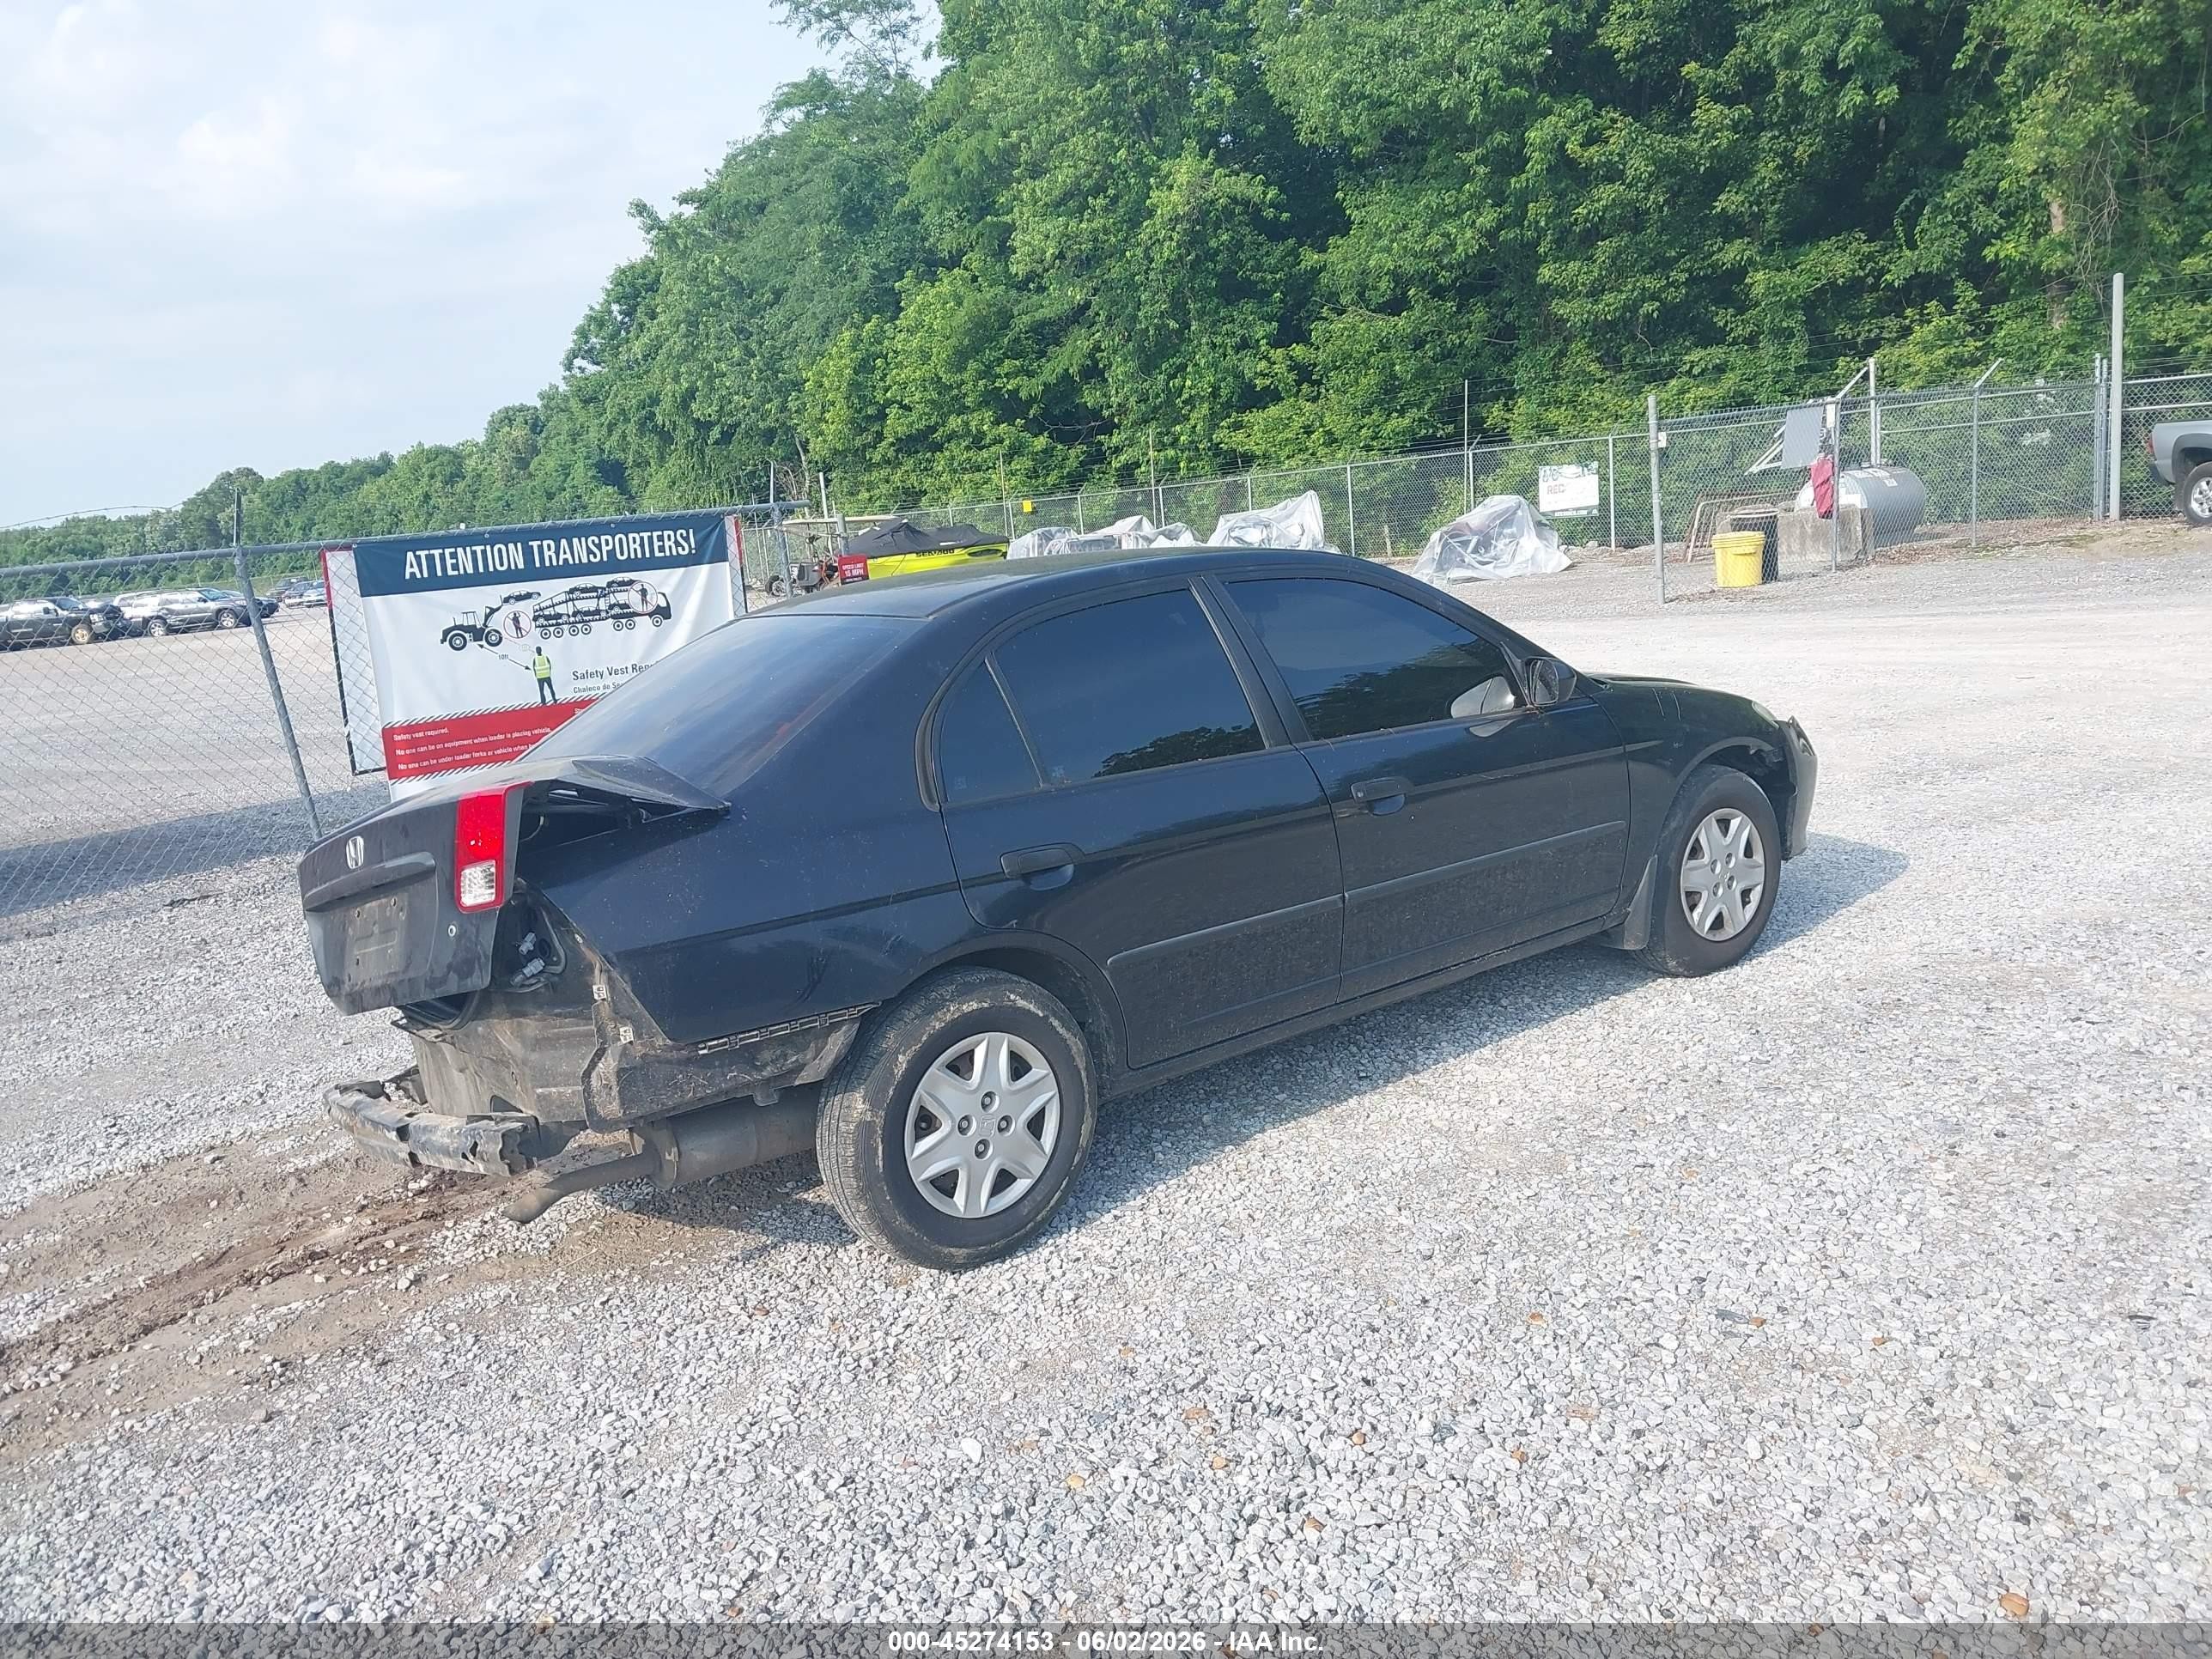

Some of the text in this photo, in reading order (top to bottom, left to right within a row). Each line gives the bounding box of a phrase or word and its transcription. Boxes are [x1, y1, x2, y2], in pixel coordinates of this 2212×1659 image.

[404, 528, 696, 580] ATTENTION TRANSPORTERS!
[572, 669, 605, 681] Safety
[606, 665, 629, 677] Vest
[573, 684, 601, 694] Chaleco
